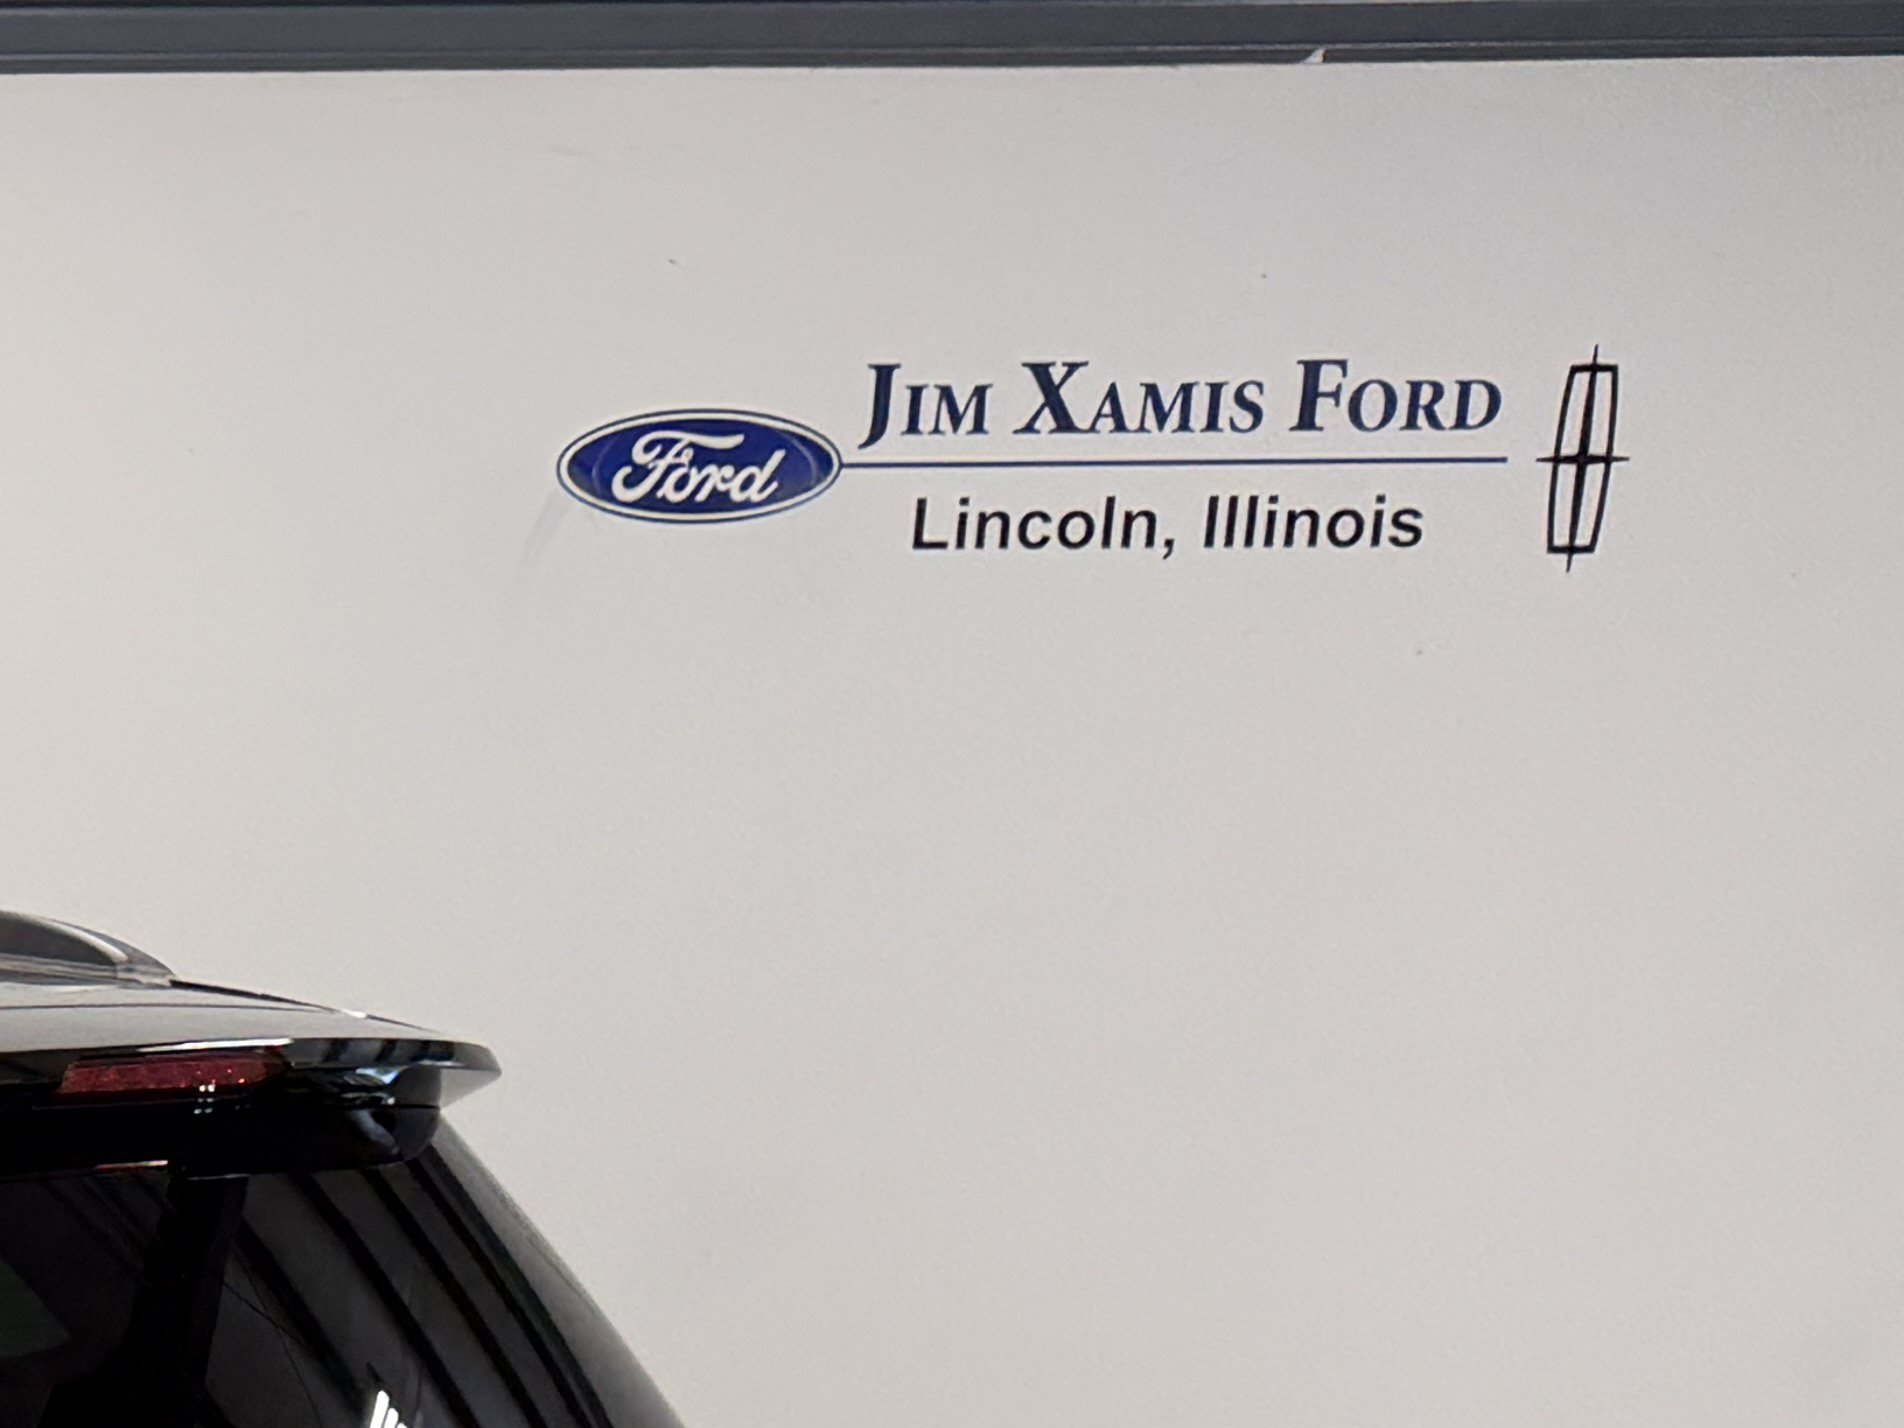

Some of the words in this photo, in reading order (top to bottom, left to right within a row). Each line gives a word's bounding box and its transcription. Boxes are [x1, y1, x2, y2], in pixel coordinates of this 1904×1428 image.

[857, 362, 995, 450] JIM
[1012, 360, 1265, 435] XAMIS
[1288, 358, 1503, 433] FORD
[610, 430, 783, 503] Ford
[910, 495, 1176, 560] Lincoln,
[1202, 494, 1424, 549] Illinois
